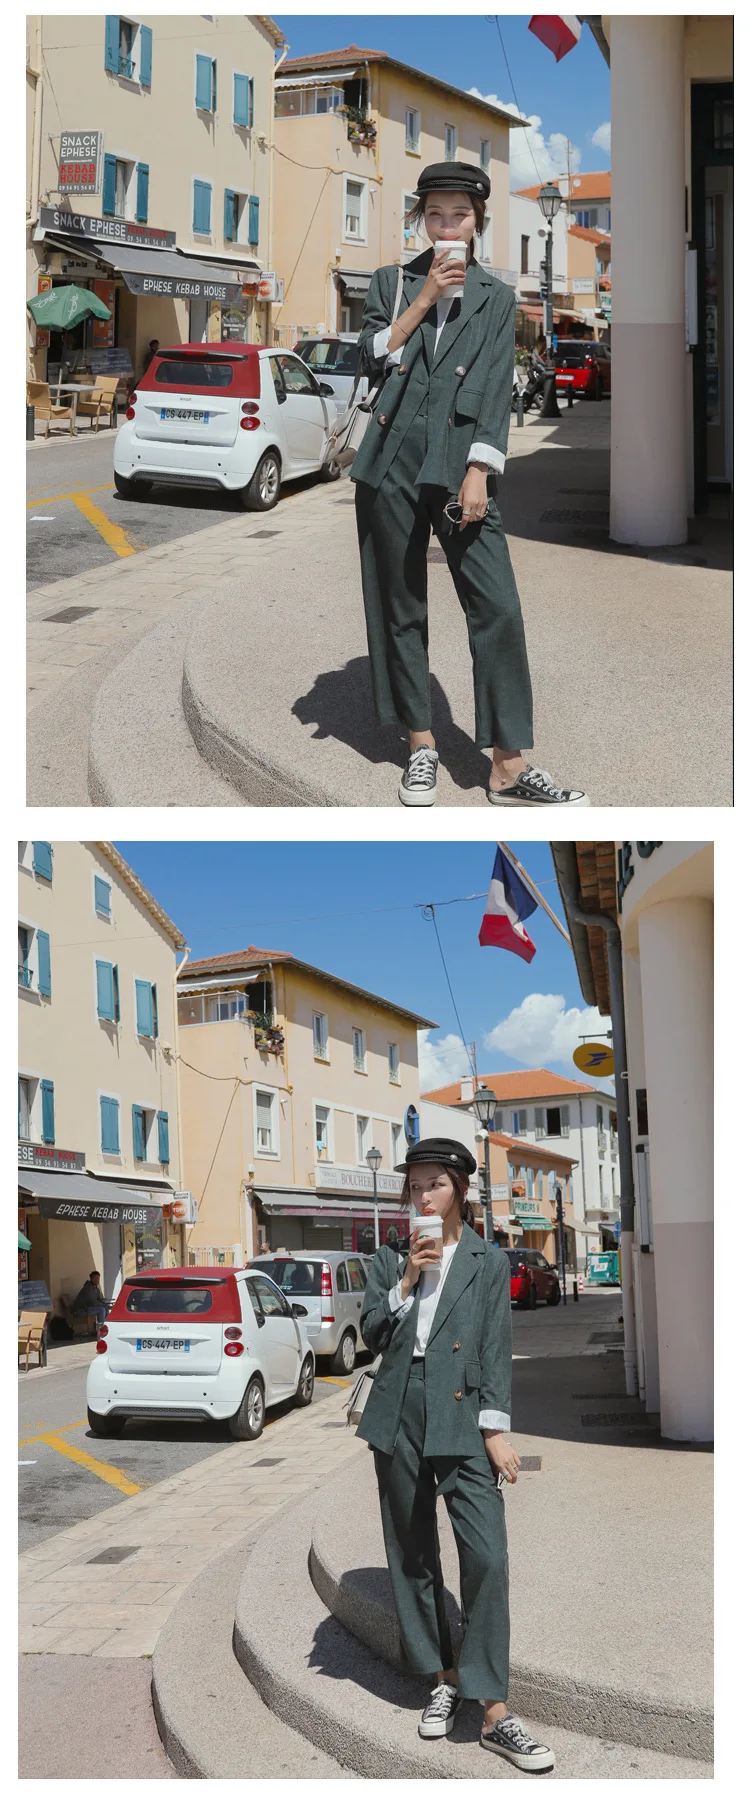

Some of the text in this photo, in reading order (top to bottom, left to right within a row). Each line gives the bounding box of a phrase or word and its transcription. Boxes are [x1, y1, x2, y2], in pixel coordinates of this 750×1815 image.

[62, 136, 96, 147] SNACK
[61, 147, 96, 157] EPHESE
[60, 163, 95, 173] KEBAB
[59, 174, 95, 184] HOUSE
[53, 212, 86, 230] SNACK
[90, 219, 126, 237] EPHESE
[143, 279, 226, 298] EPHESE KEBAB HOUSE
[35, 1148, 55, 1158] KEBAB
[57, 1151, 76, 1160] HOUSE
[56, 1204, 147, 1220] EPHESE KEBAB HOUSE
[142, 1339, 184, 1350] CS-447-EP
